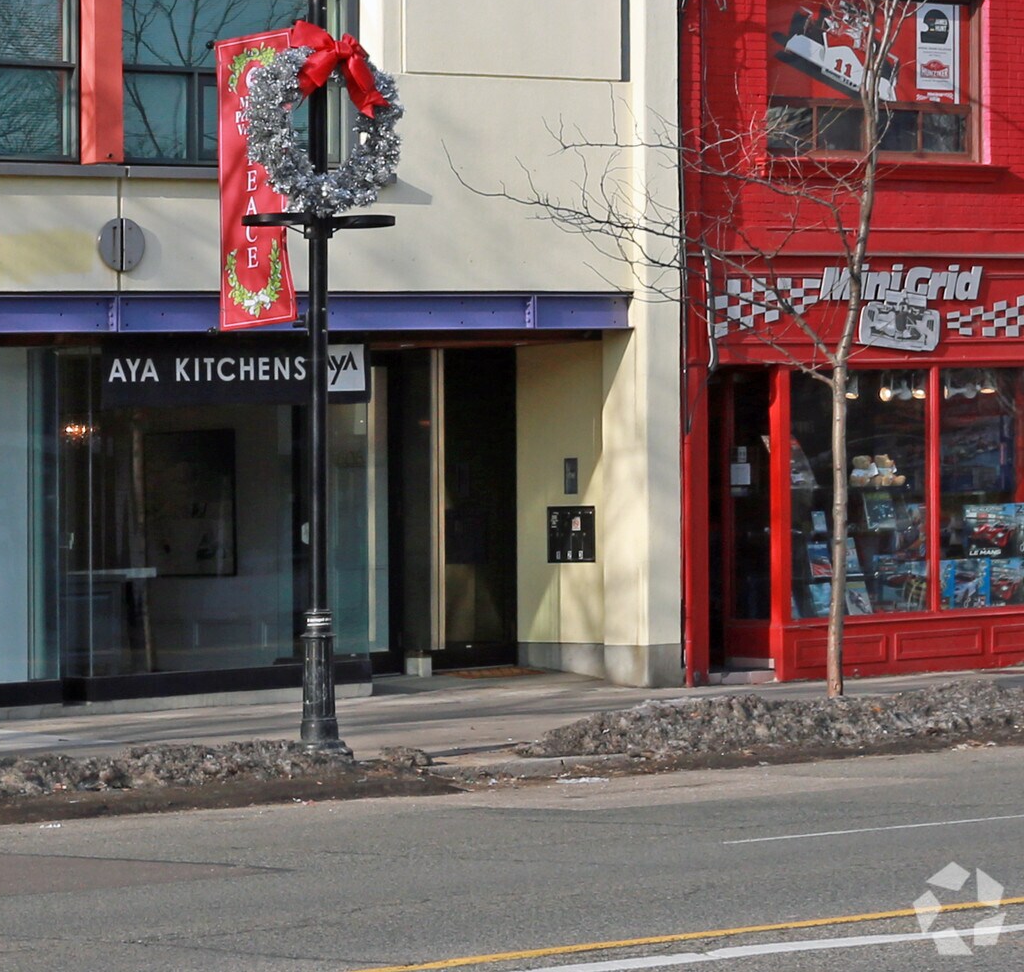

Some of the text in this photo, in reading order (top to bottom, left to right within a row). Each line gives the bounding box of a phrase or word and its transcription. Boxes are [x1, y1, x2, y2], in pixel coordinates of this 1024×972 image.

[245, 159, 260, 268] EACE
[108, 356, 306, 382] AYA KITCHENS
